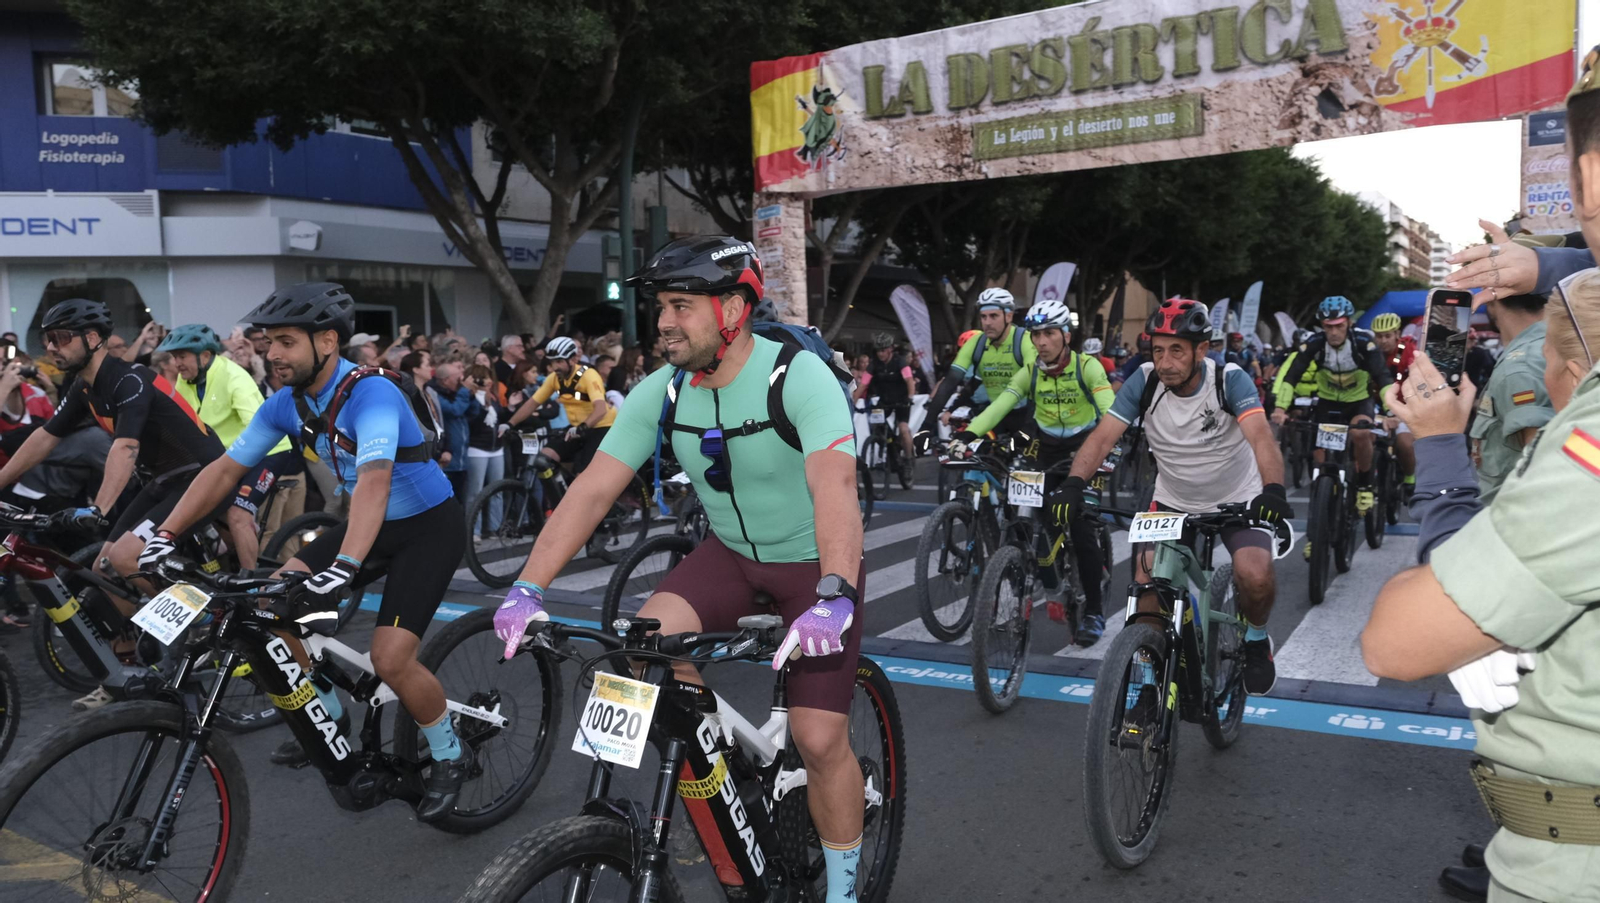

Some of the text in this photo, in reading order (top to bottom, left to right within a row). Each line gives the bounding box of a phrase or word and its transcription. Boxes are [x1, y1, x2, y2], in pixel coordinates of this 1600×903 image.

[863, 0, 1349, 119] LA DESÉRTICA
[994, 111, 1176, 145] La Legión y el desierto nos une
[41, 131, 119, 147] Logopedia
[38, 150, 125, 166] Fisioterapia
[1528, 191, 1571, 203] RENTA
[711, 244, 748, 261] GASGAS
[1043, 397, 1077, 405] EKOKAI
[1012, 483, 1041, 497] 10174
[1136, 517, 1179, 531] 10127
[150, 595, 191, 628] 10094
[586, 700, 642, 741] 10020
[679, 773, 717, 789] ONTROL
